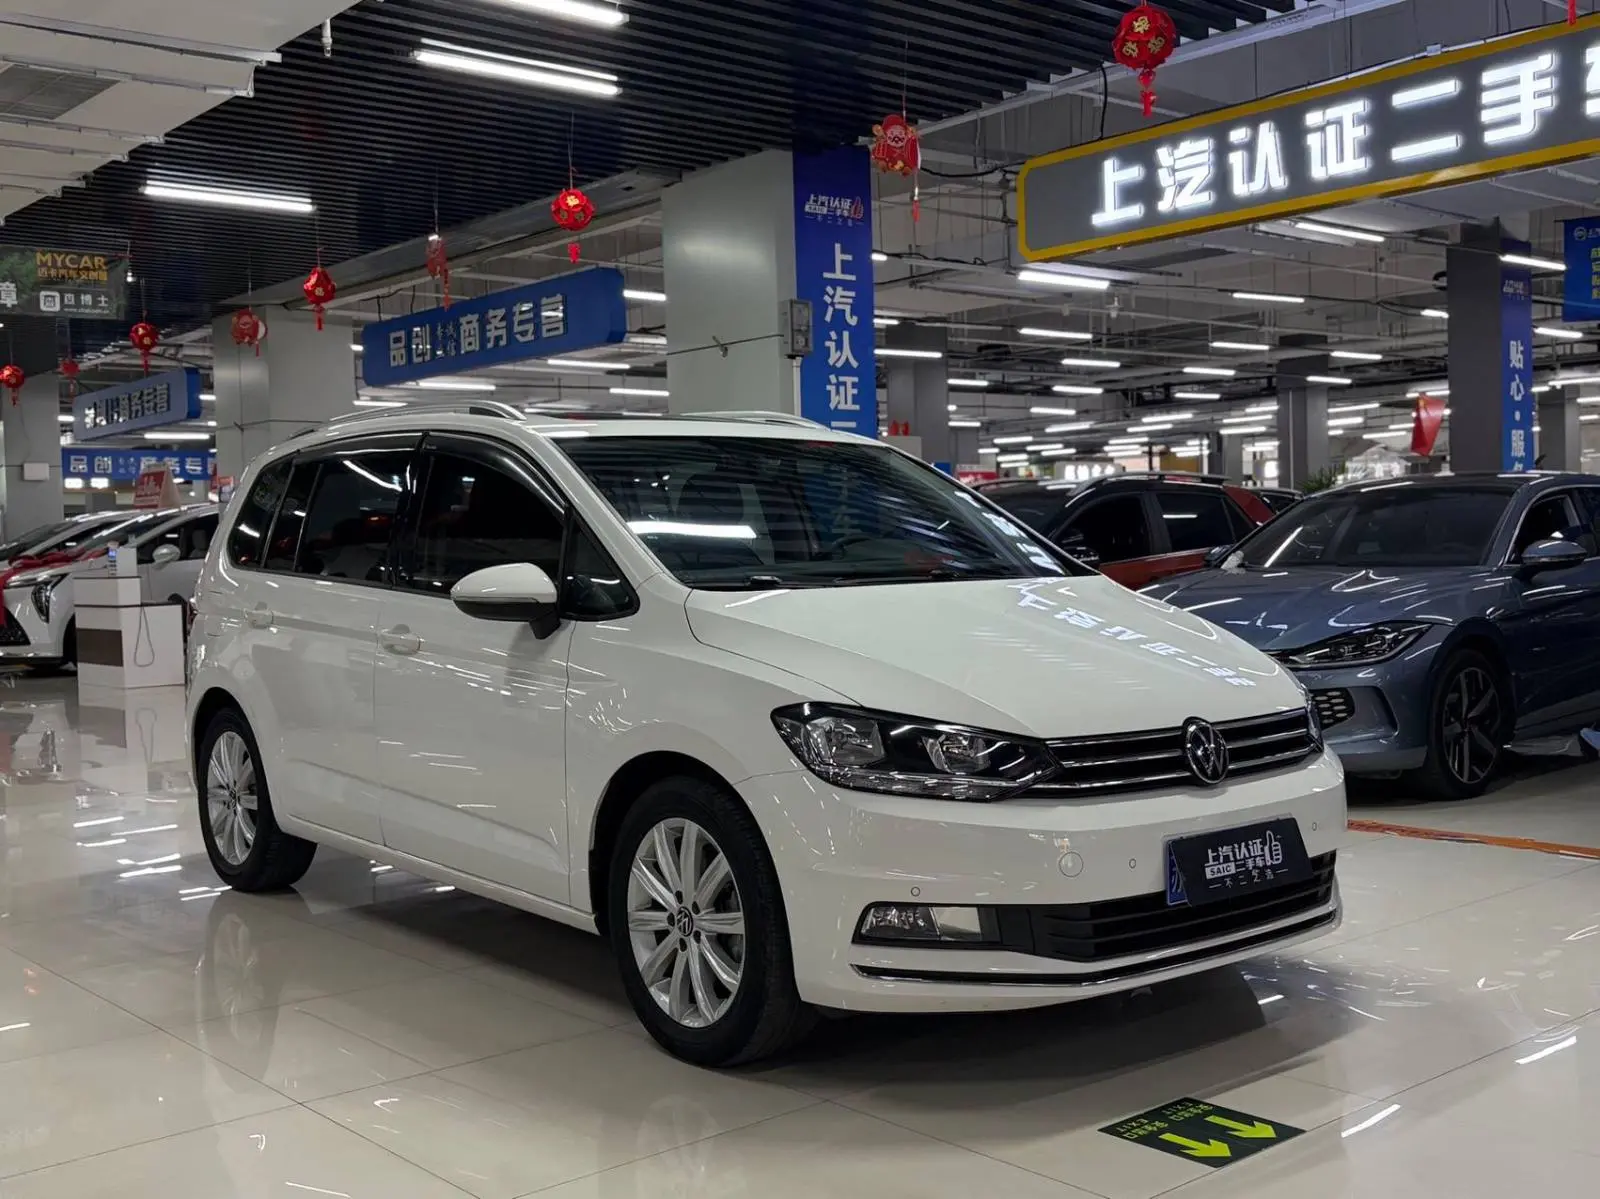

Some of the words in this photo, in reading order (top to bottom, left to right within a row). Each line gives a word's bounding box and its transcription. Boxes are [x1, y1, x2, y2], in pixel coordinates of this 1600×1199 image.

[808, 193, 852, 209] 上汽认证
[36, 252, 108, 270] MYCAR
[389, 324, 431, 368] 品创
[459, 293, 566, 355] 商务专营
[1204, 838, 1264, 866] 上汽认证
[1209, 866, 1234, 876] SAIC
[1235, 856, 1265, 872] 二手车
